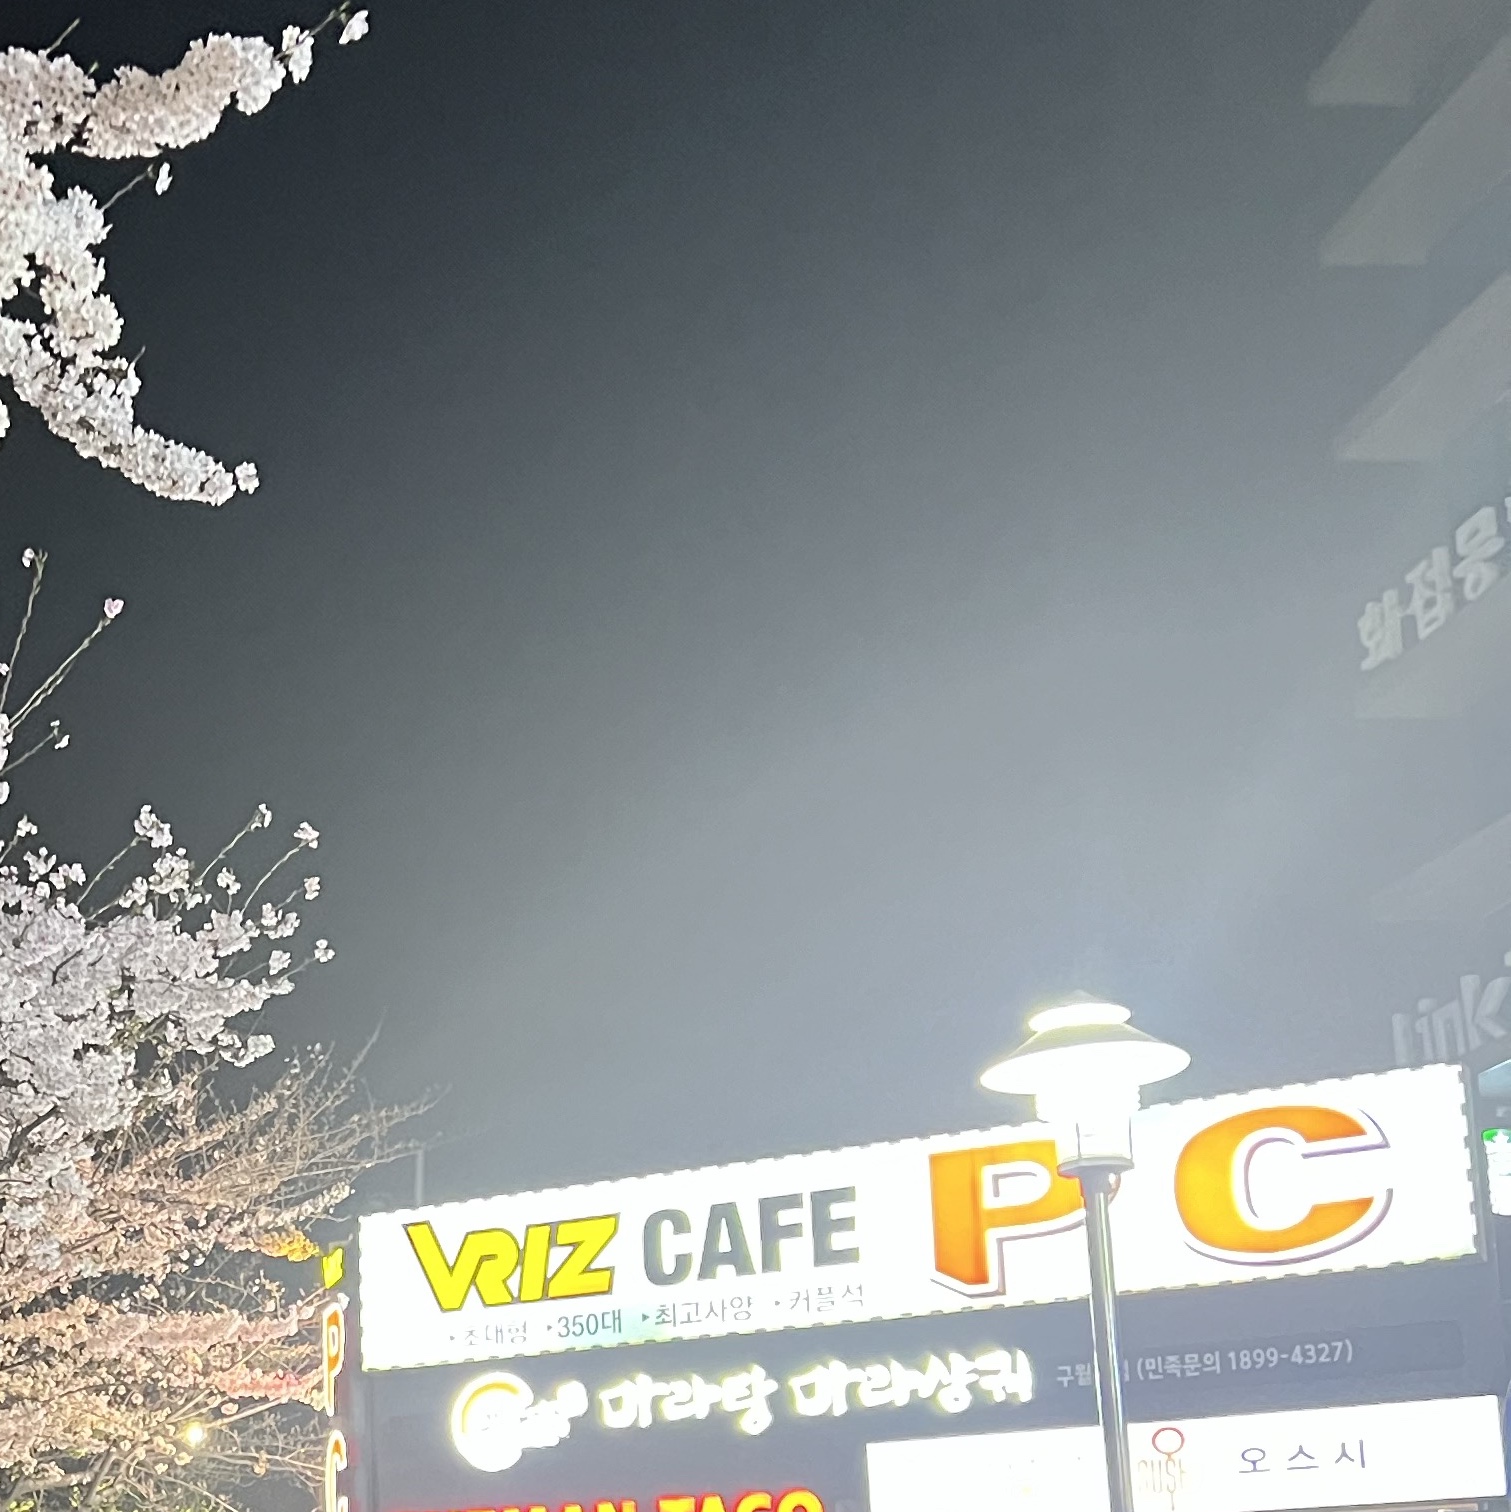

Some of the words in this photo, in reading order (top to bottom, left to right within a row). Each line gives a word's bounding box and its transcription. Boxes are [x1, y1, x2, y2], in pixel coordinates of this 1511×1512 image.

[402, 1212, 621, 1313] VRIZ
[642, 1186, 861, 1287] CAFE
[556, 1309, 623, 1339] 350대
[654, 1295, 754, 1327] 최고사양
[788, 1284, 865, 1314] 커플석
[1228, 1339, 1353, 1371] 1899-4327)
